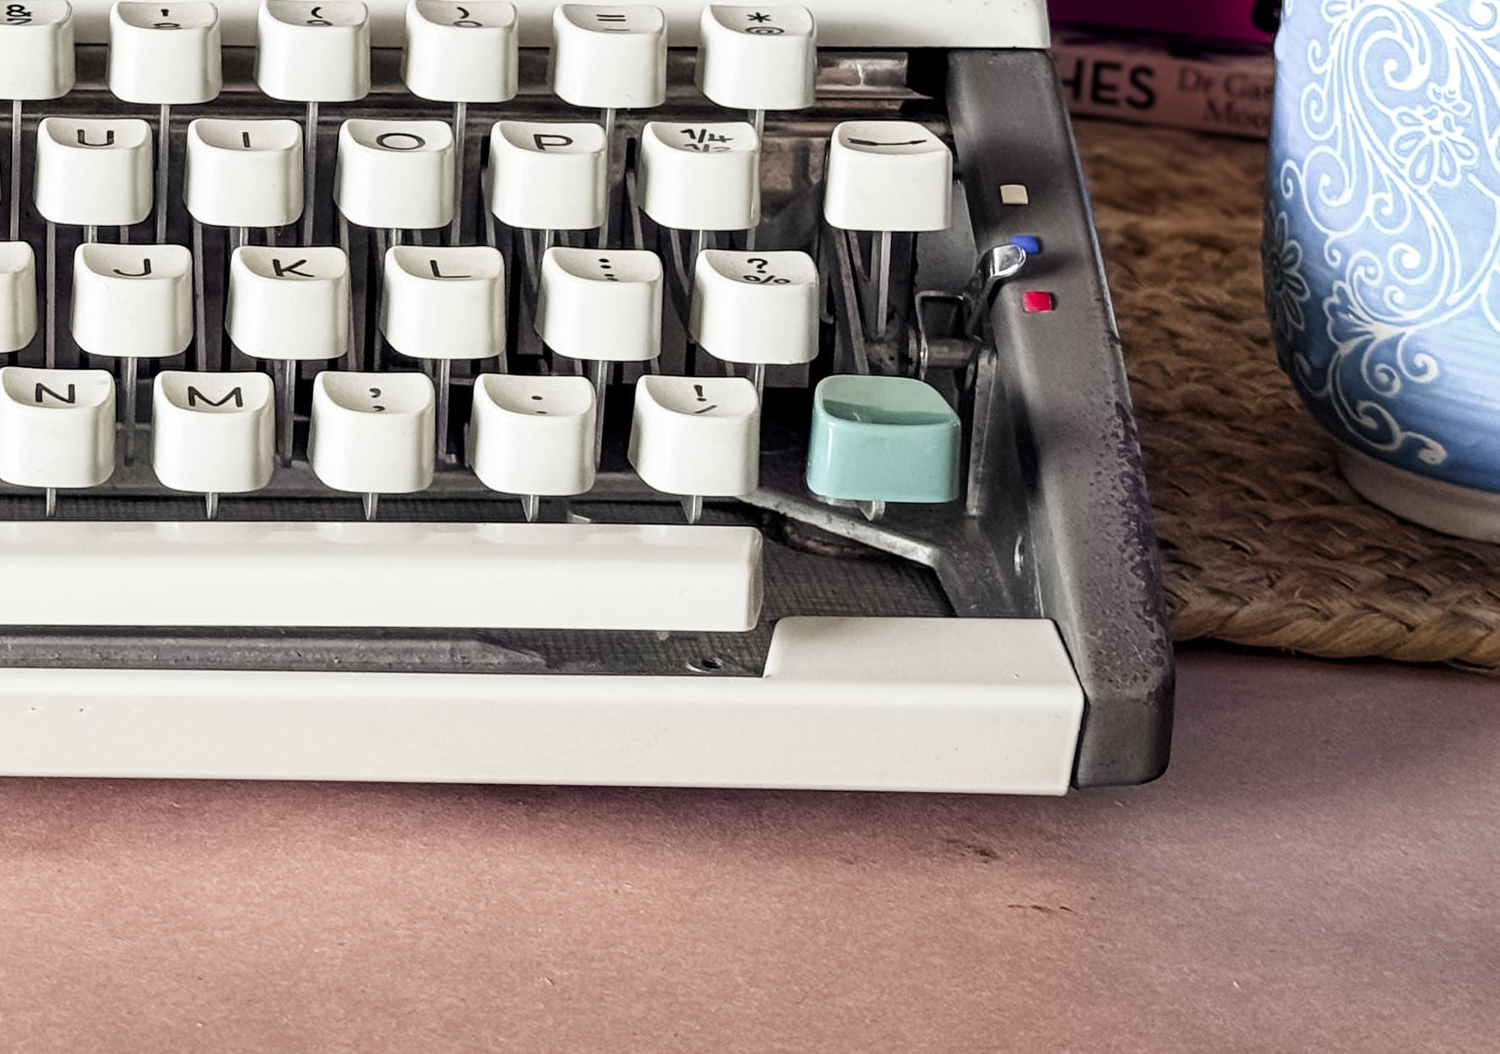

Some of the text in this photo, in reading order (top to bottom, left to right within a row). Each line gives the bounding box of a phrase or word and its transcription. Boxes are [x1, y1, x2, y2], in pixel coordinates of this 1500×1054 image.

[5, 4, 32, 18] &
[1177, 65, 1213, 94] Dr
[74, 129, 114, 147] U
[243, 132, 251, 148] I
[375, 132, 426, 151] O
[530, 134, 573, 151] P
[113, 259, 151, 276] J
[273, 259, 314, 277] K
[430, 260, 471, 278] L
[747, 258, 768, 273] ?
[35, 383, 75, 404] N
[188, 386, 243, 408] M
[694, 385, 706, 401] !
